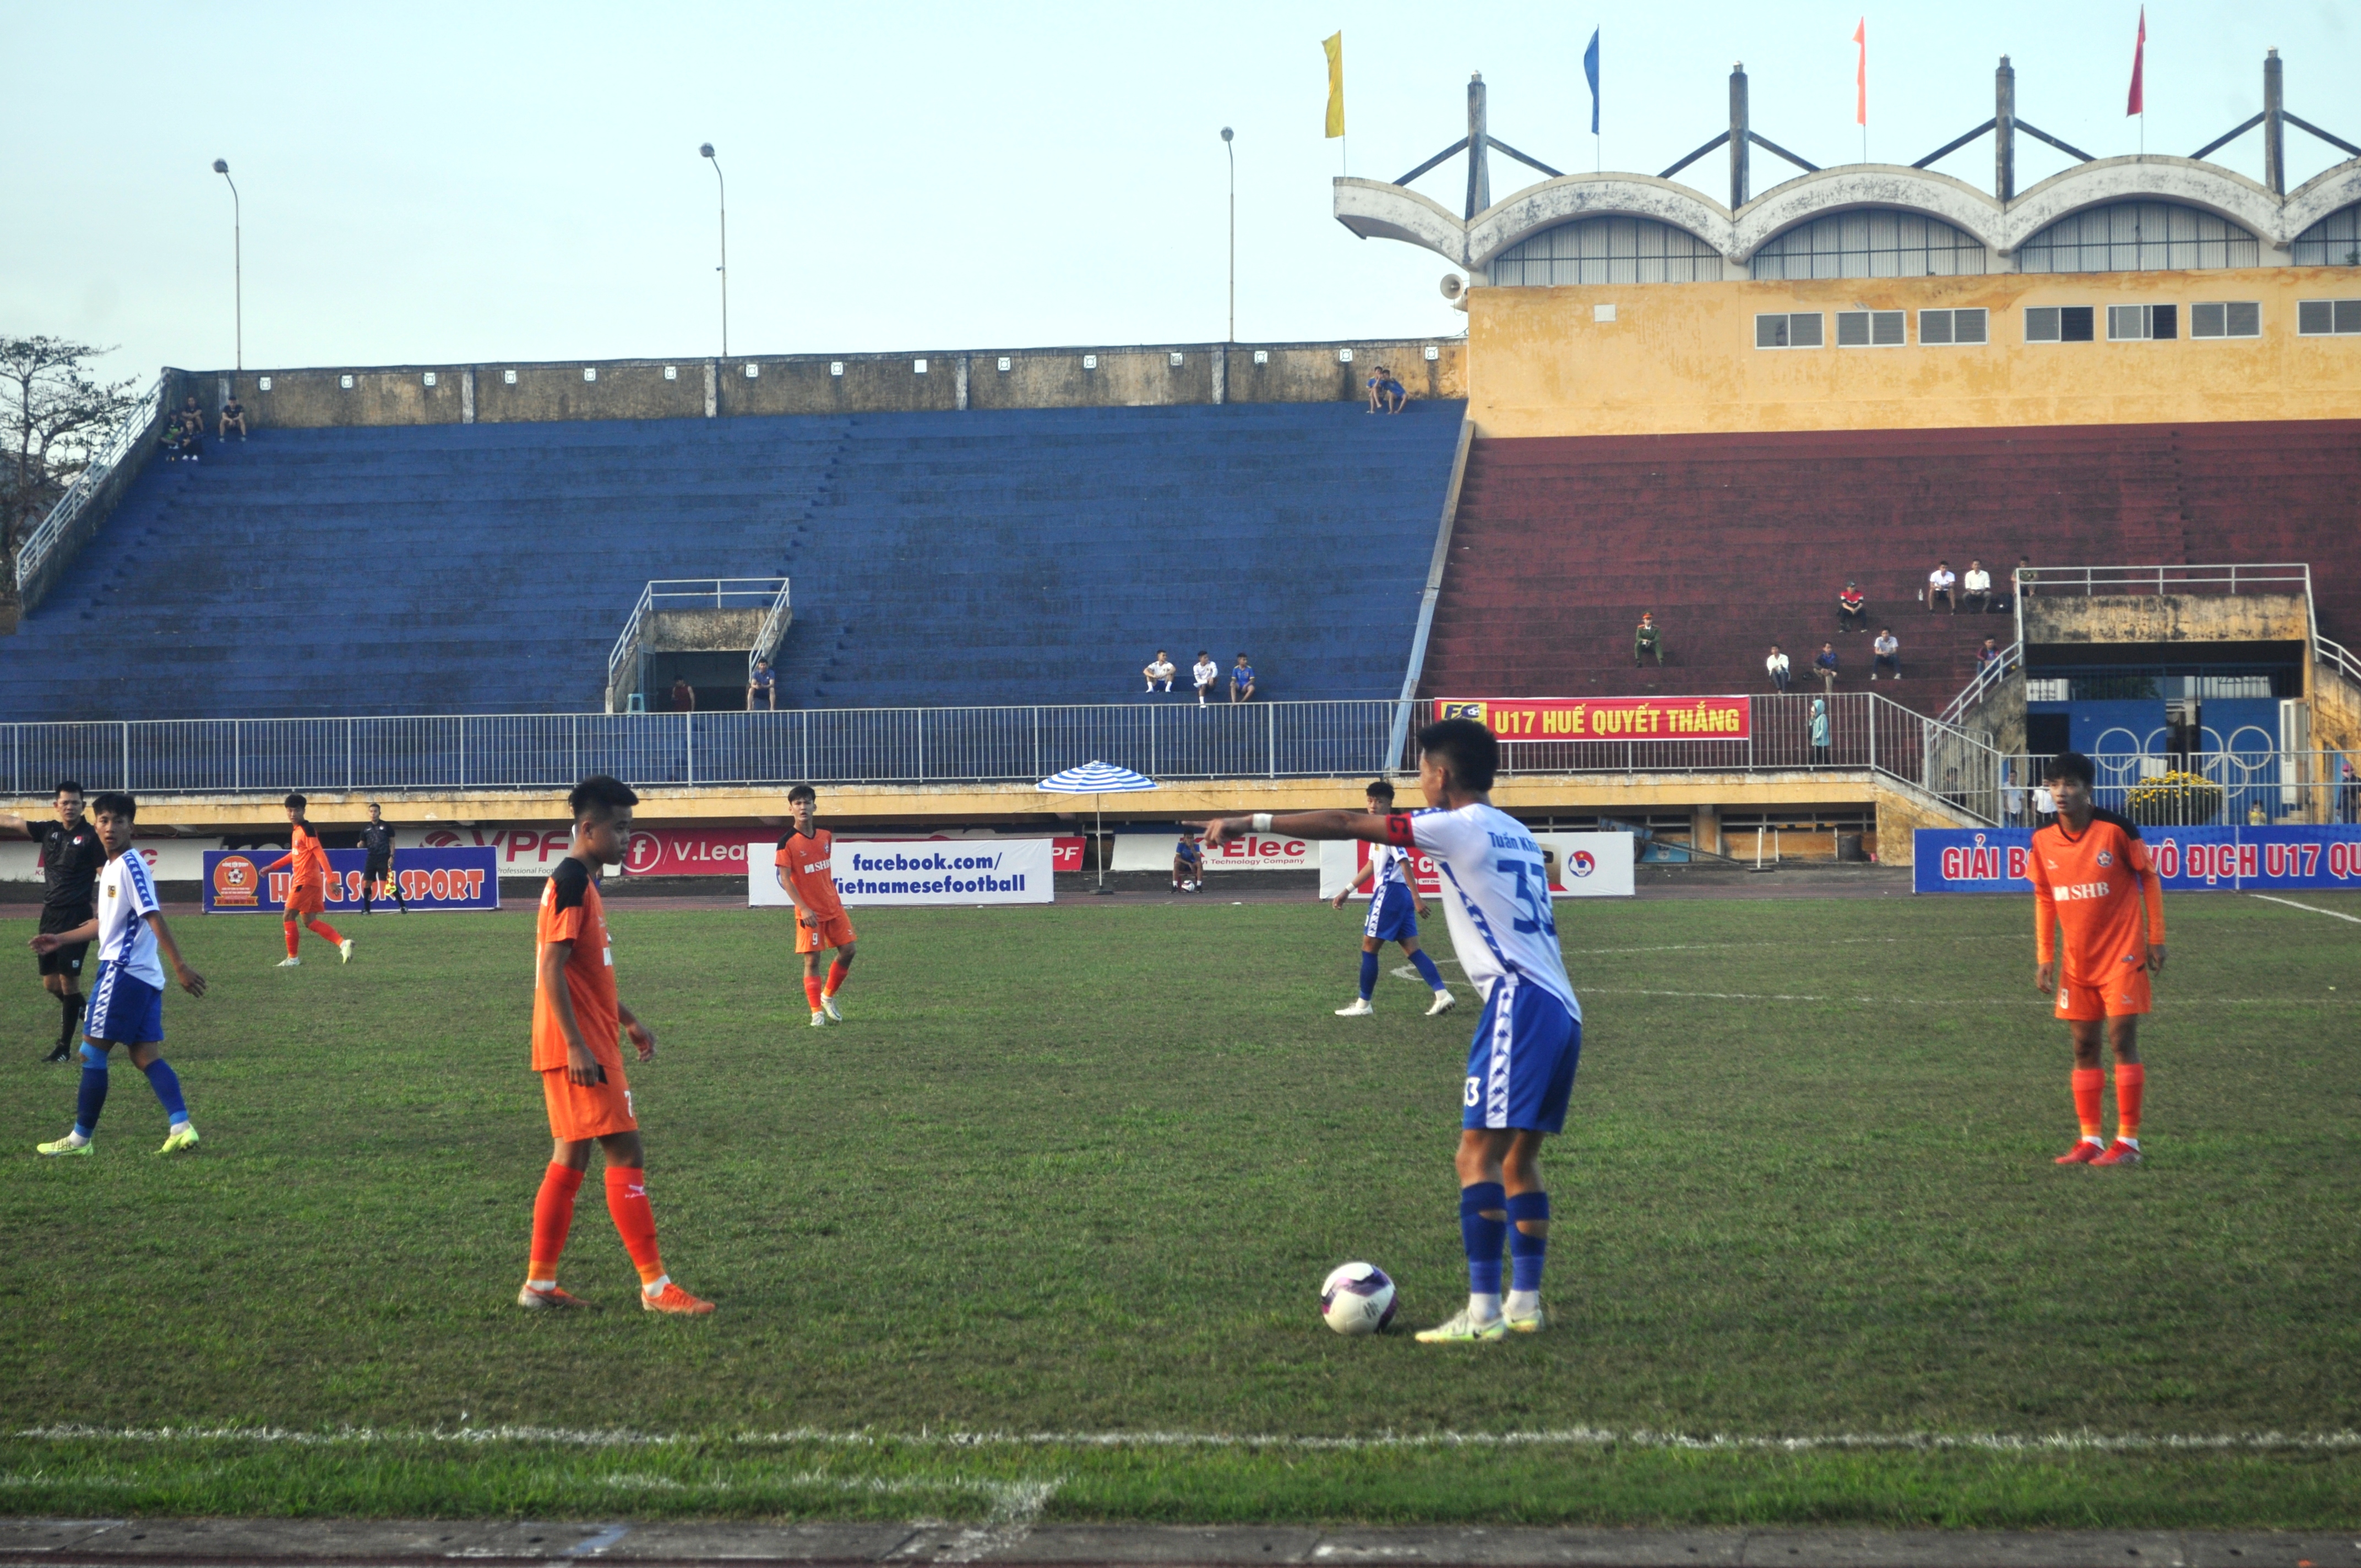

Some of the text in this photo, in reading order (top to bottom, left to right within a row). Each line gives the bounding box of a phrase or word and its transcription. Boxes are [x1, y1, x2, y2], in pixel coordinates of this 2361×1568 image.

[1494, 700, 1739, 736] U17 HUẾ QUYẾT THẮNG
[471, 830, 570, 862] VPF
[673, 842, 749, 863] V.Lea
[814, 859, 830, 872] SHB
[853, 852, 1003, 871] facebook.com/
[1942, 833, 2000, 881] GIẢI
[2186, 843, 2258, 885] ĐỊCH
[2265, 843, 2321, 878] U17
[399, 869, 485, 901] SPORT
[2071, 882, 2110, 901] SHB
[812, 933, 818, 945] 9
